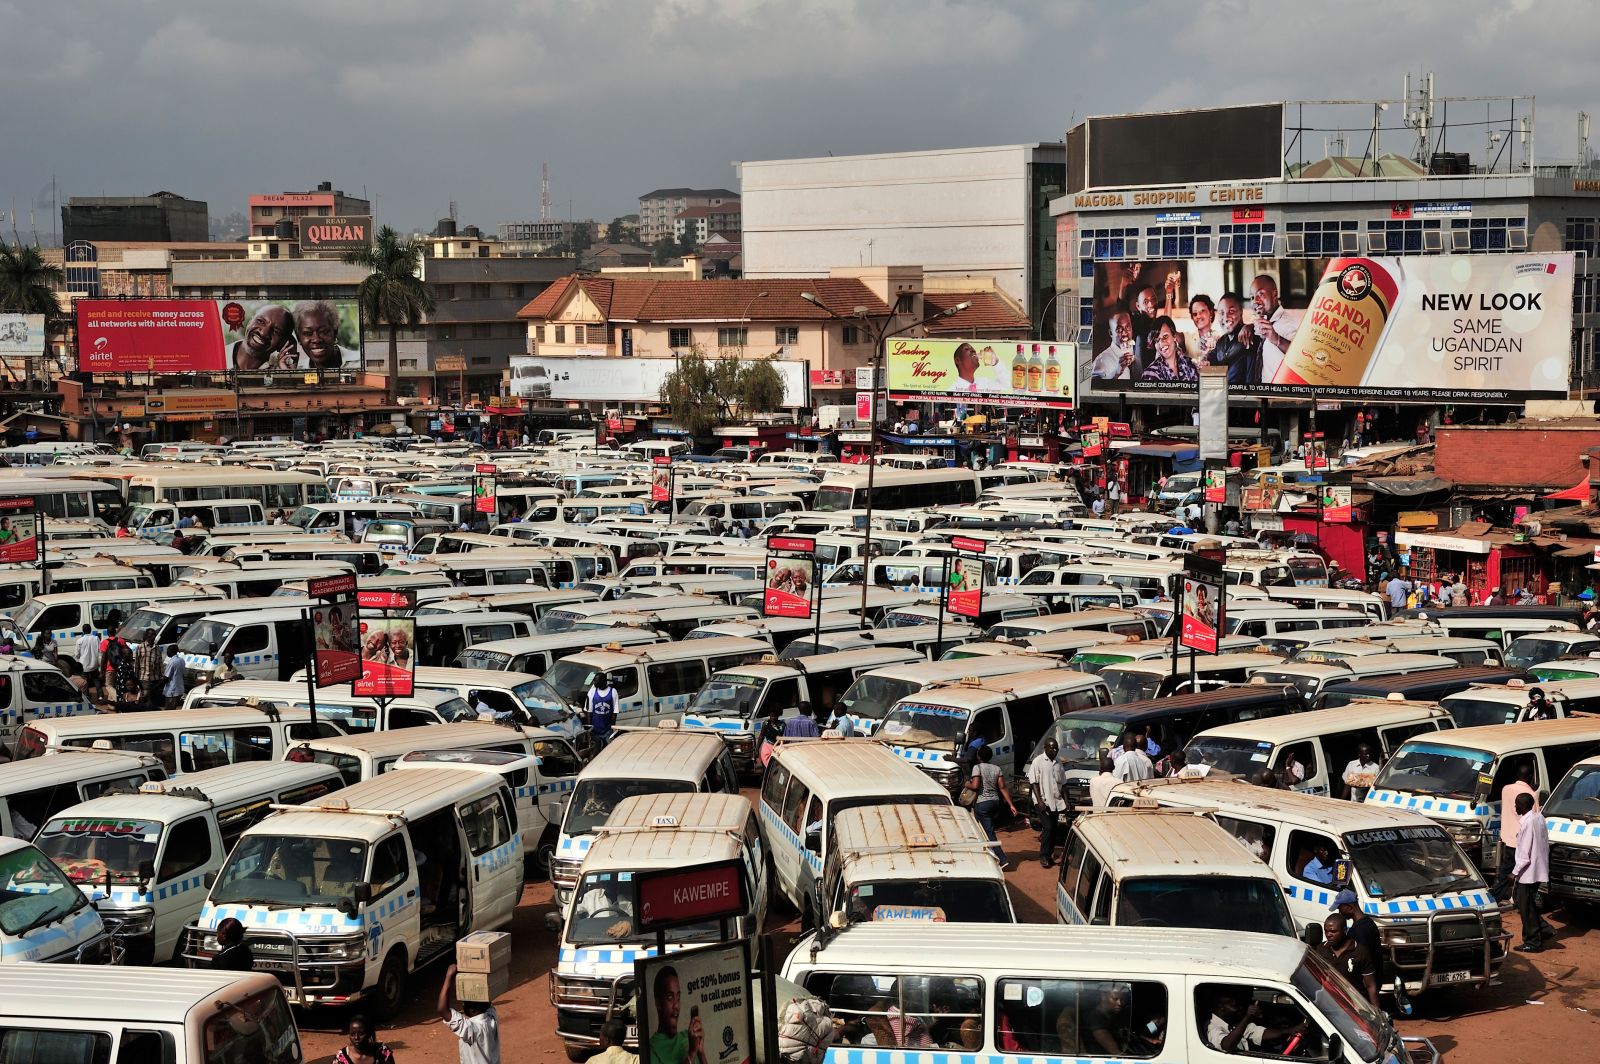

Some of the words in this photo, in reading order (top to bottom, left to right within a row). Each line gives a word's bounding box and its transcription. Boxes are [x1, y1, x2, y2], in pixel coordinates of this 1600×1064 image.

[1074, 194, 1124, 208] MAGOBA
[1133, 191, 1196, 206] SHOPPING
[1209, 188, 1263, 202] CENTRE
[308, 225, 364, 244] QURAN
[1422, 294, 1473, 310] NEW
[1480, 293, 1542, 310] LOOK
[88, 310, 106, 318] send
[108, 310, 122, 318] and
[124, 310, 151, 318] receive
[152, 312, 178, 320] money
[1315, 296, 1371, 334] UGANDA
[88, 320, 99, 328] all
[100, 320, 136, 328] networks
[1310, 310, 1365, 348] WARAGI
[1453, 319, 1502, 334] SAME
[1310, 328, 1339, 344] PREMIUM
[1340, 341, 1352, 352] GIN
[1432, 338, 1522, 352] UGANDAN
[90, 352, 112, 360] airtel
[892, 342, 930, 360] Leading
[1454, 357, 1503, 370] SPIRIT
[912, 362, 948, 384] Waragi
[320, 670, 332, 678] airtel
[673, 881, 729, 904] KAWEMPE
[877, 908, 934, 919] KAWEMPE
[687, 980, 699, 994] get
[700, 975, 717, 990] 50%
[718, 971, 740, 983] bonus
[701, 993, 708, 1003] to
[708, 990, 720, 1002] call
[721, 987, 741, 998] across
[714, 998, 742, 1012] networks
